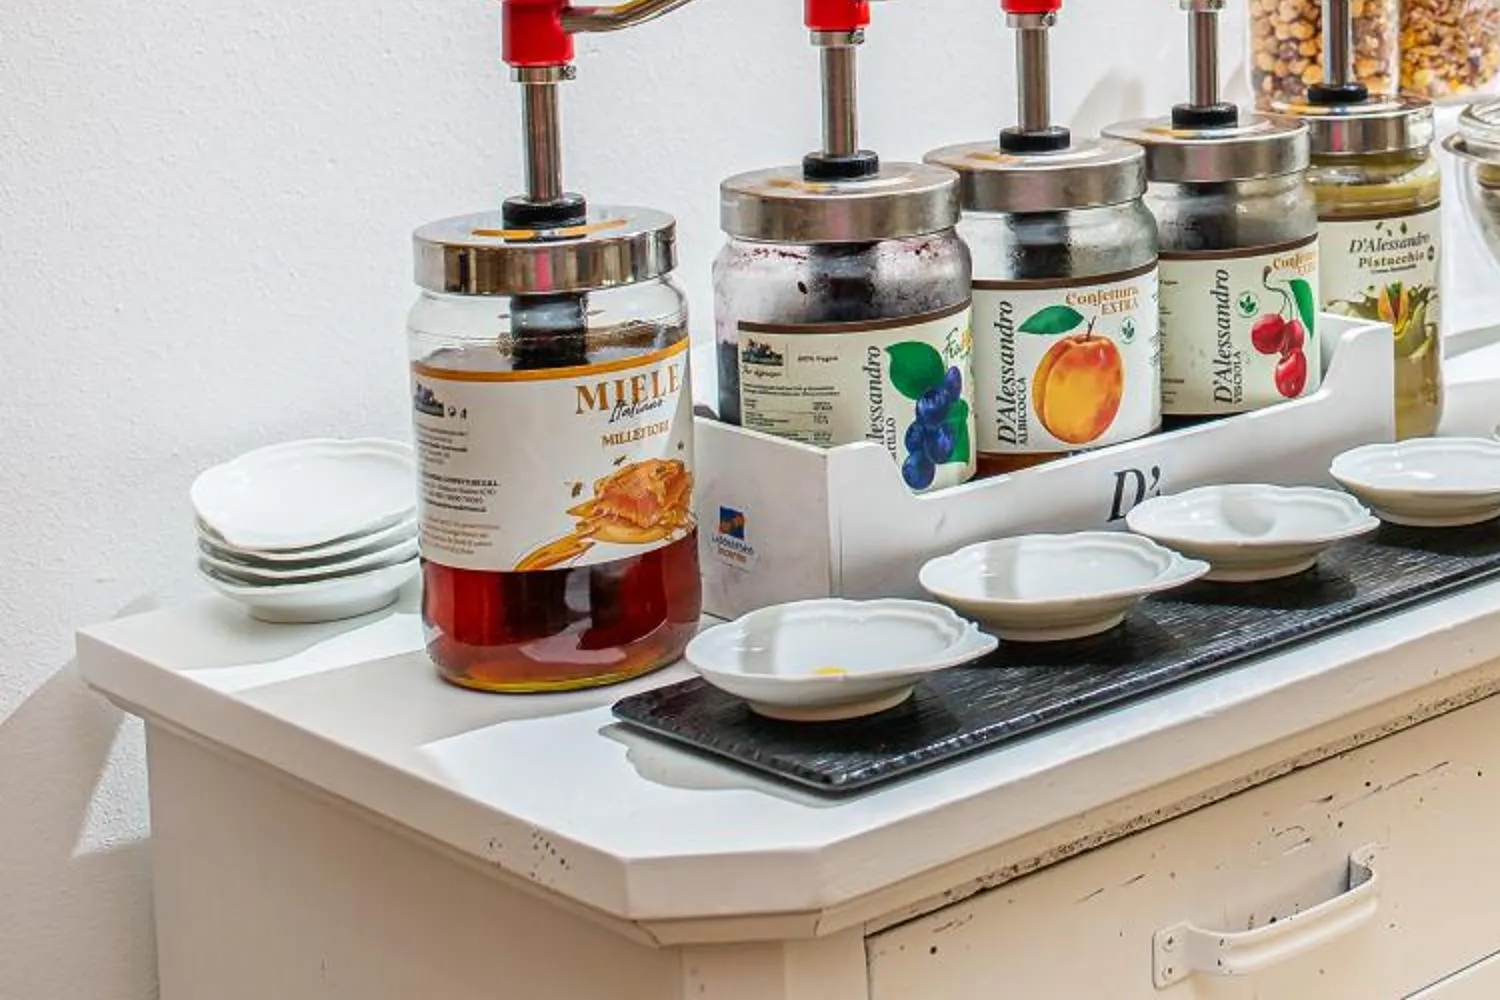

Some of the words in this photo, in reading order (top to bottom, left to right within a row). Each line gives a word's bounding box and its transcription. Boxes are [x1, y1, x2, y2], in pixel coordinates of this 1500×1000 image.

[1349, 232, 1430, 253] D'Alessandro
[1359, 250, 1425, 268] Pistacchio
[1066, 285, 1139, 306] Confettura
[1101, 298, 1140, 315] EXTRA
[1210, 269, 1233, 404] D'Alessandro
[575, 364, 681, 415] MIELE
[862, 345, 885, 445] lessandro
[994, 300, 1017, 445] D'Alessandro
[1233, 351, 1243, 405] VISCIOLA
[602, 420, 670, 446] MILLEFIORI
[1016, 377, 1028, 446] ALBICOCCA
